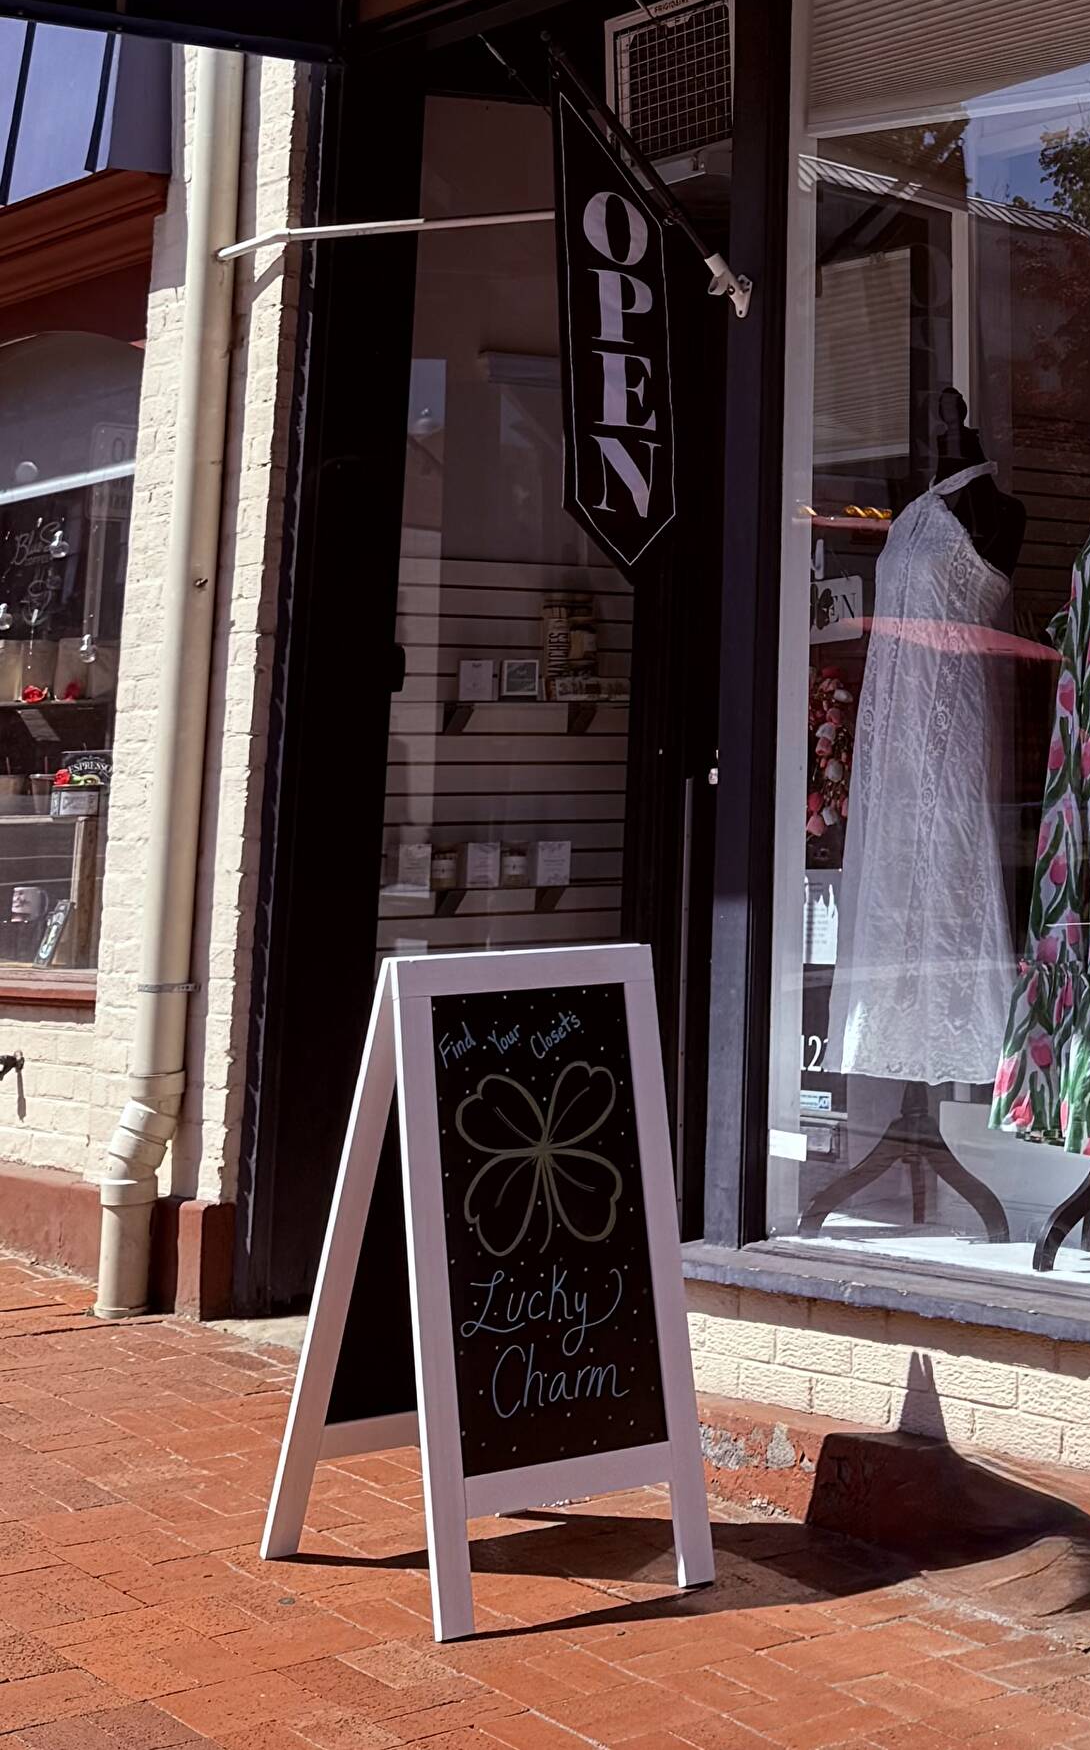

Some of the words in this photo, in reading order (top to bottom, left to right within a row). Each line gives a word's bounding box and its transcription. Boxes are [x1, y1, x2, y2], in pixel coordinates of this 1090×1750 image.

[582, 190, 657, 519] OPEN
[547, 632, 570, 678] MATCHES
[438, 1021, 477, 1069] Find
[487, 1024, 520, 1055] Your
[461, 1264, 623, 1356] Lucky
[492, 1343, 630, 1418] Charm
